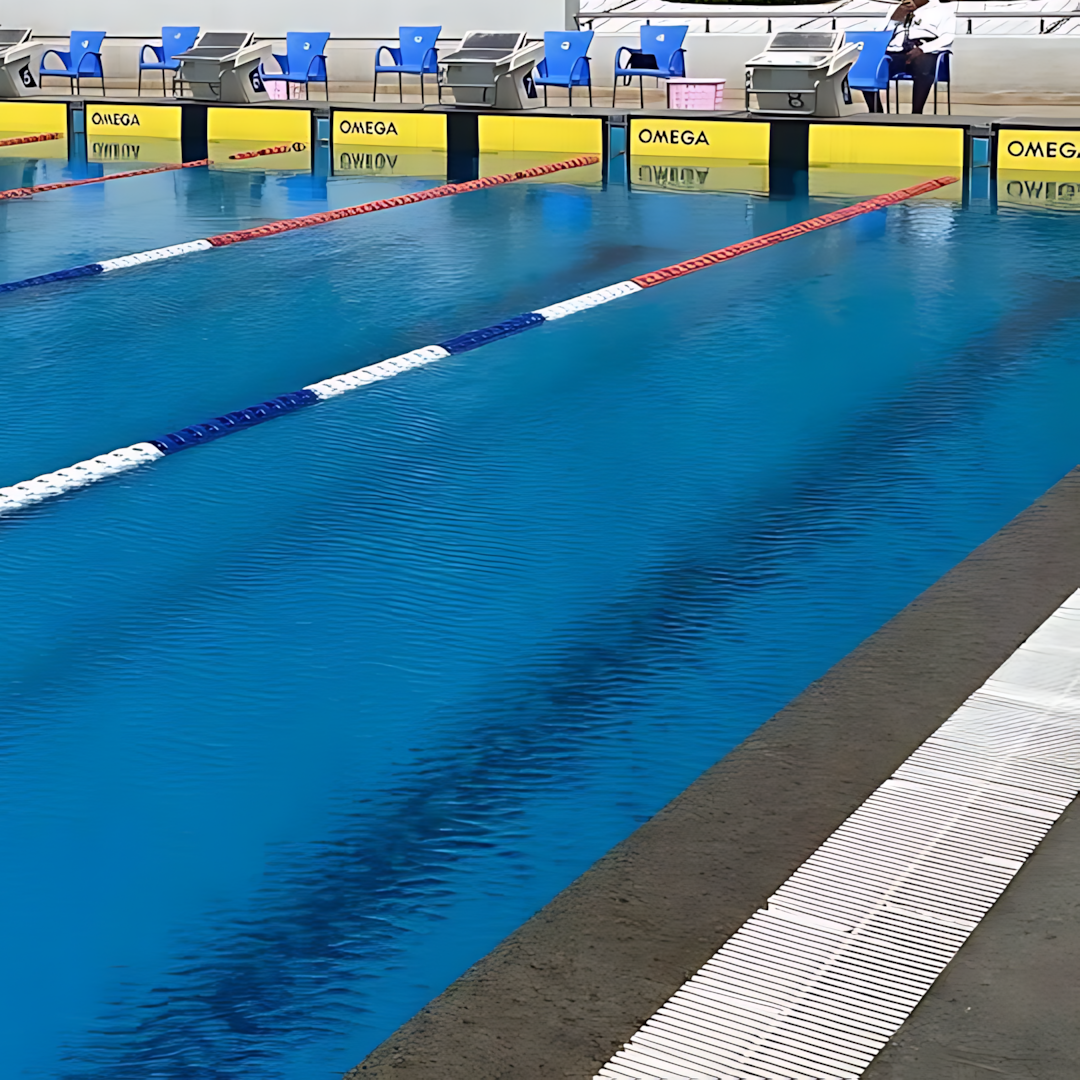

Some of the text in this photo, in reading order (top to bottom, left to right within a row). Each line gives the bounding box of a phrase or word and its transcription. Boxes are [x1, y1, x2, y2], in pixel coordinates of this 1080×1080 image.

[91, 111, 141, 127] OMEGA
[339, 119, 399, 136] OMEGA
[638, 128, 711, 146] OMEGA
[1006, 140, 1080, 159] OMEG
